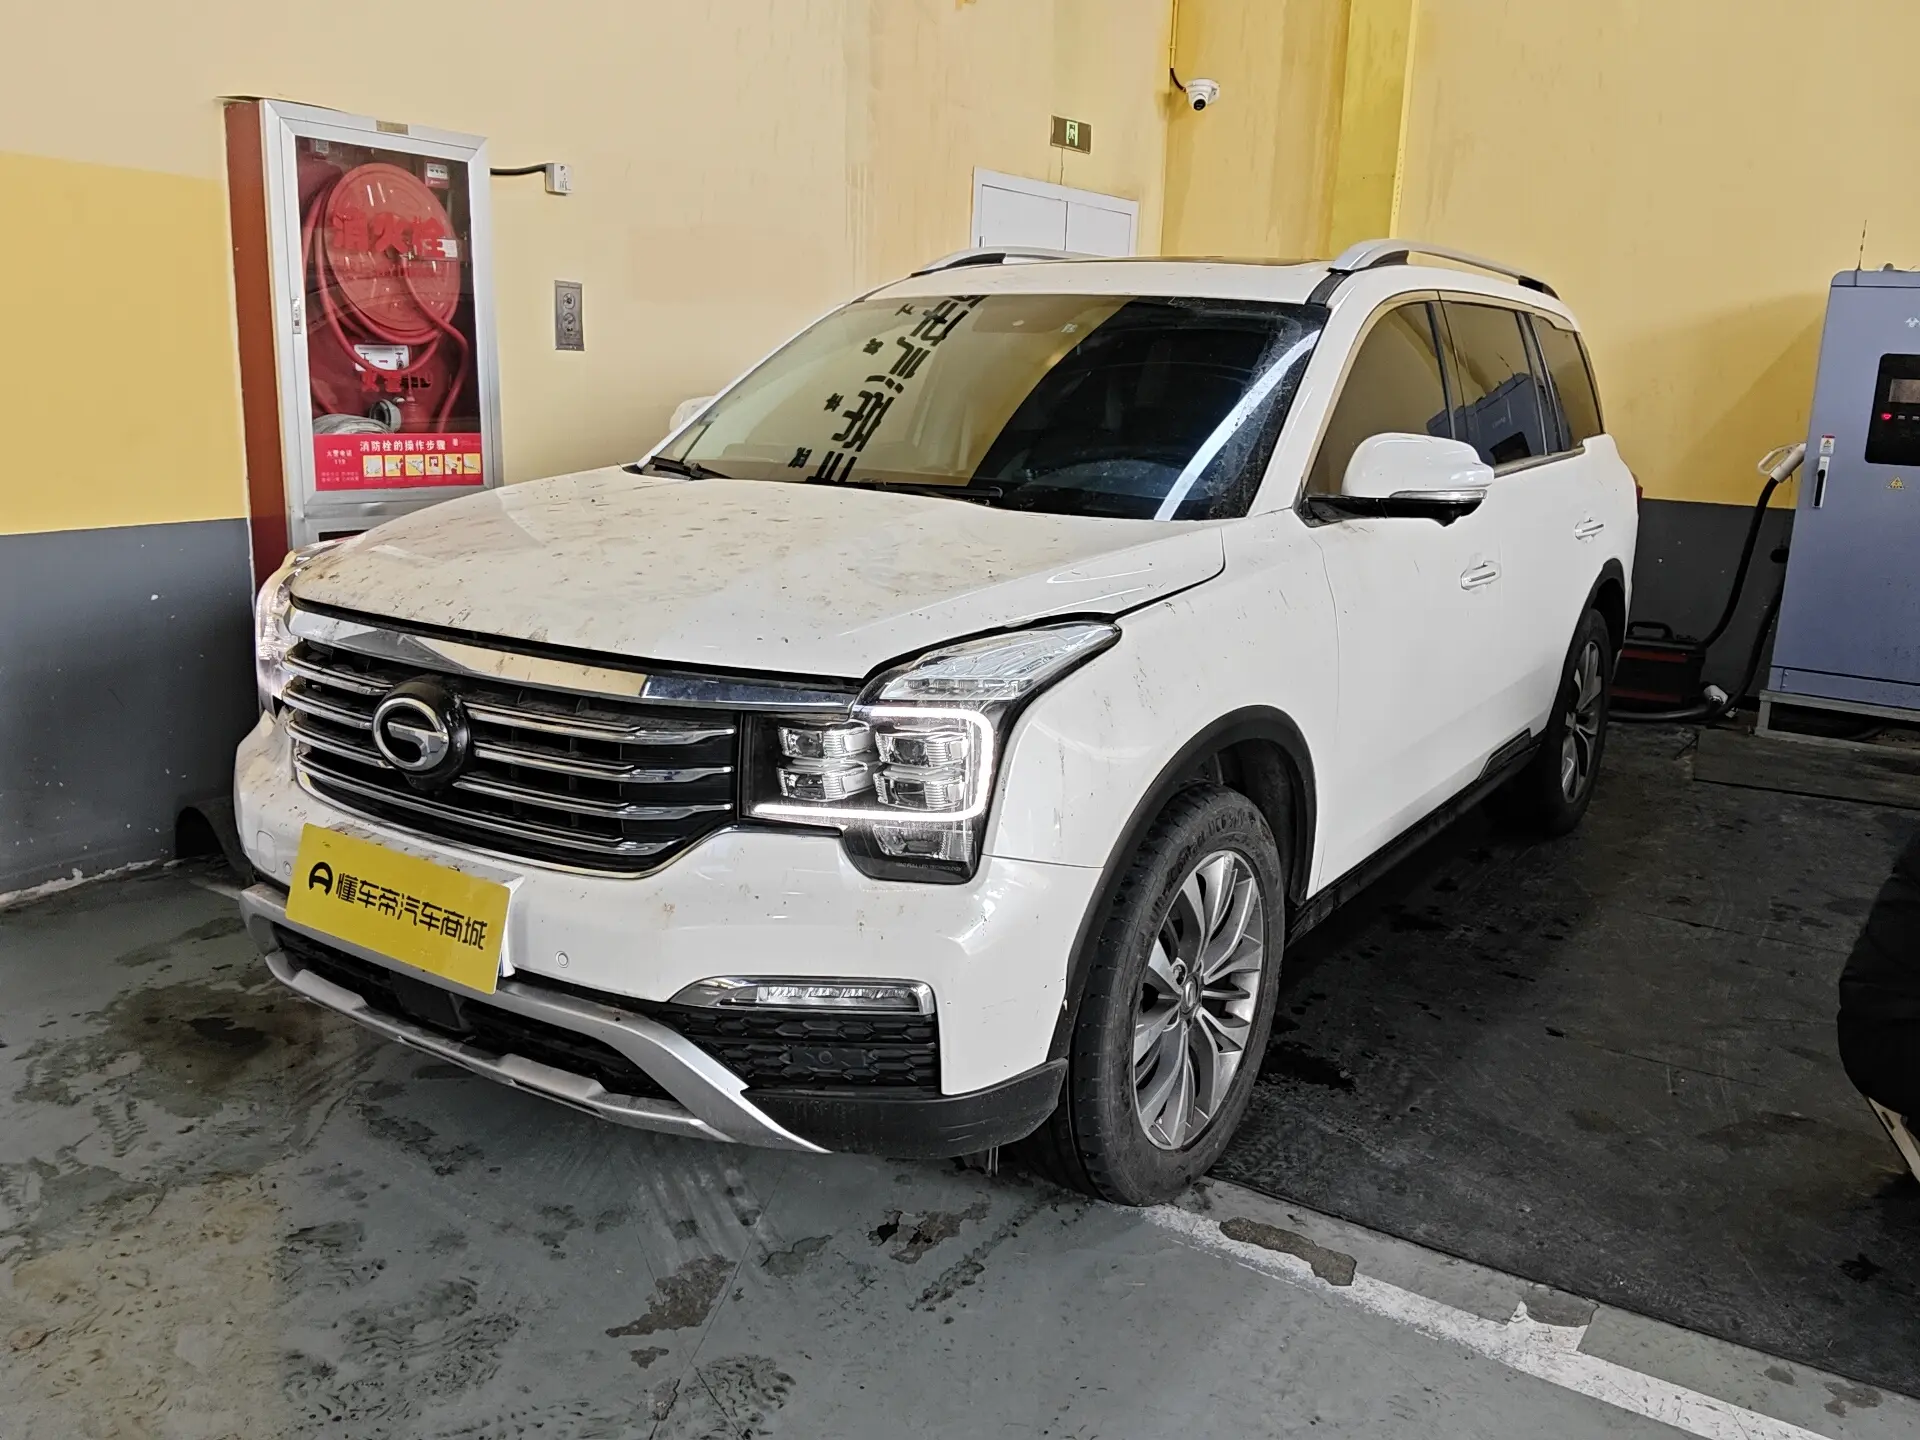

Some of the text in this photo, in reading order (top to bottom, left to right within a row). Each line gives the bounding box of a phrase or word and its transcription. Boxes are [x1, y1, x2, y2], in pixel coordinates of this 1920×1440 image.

[332, 208, 446, 258] 消火栓
[359, 439, 447, 452] 消防栓的操作步骤
[336, 872, 489, 951] 懂车帝汽车商城
